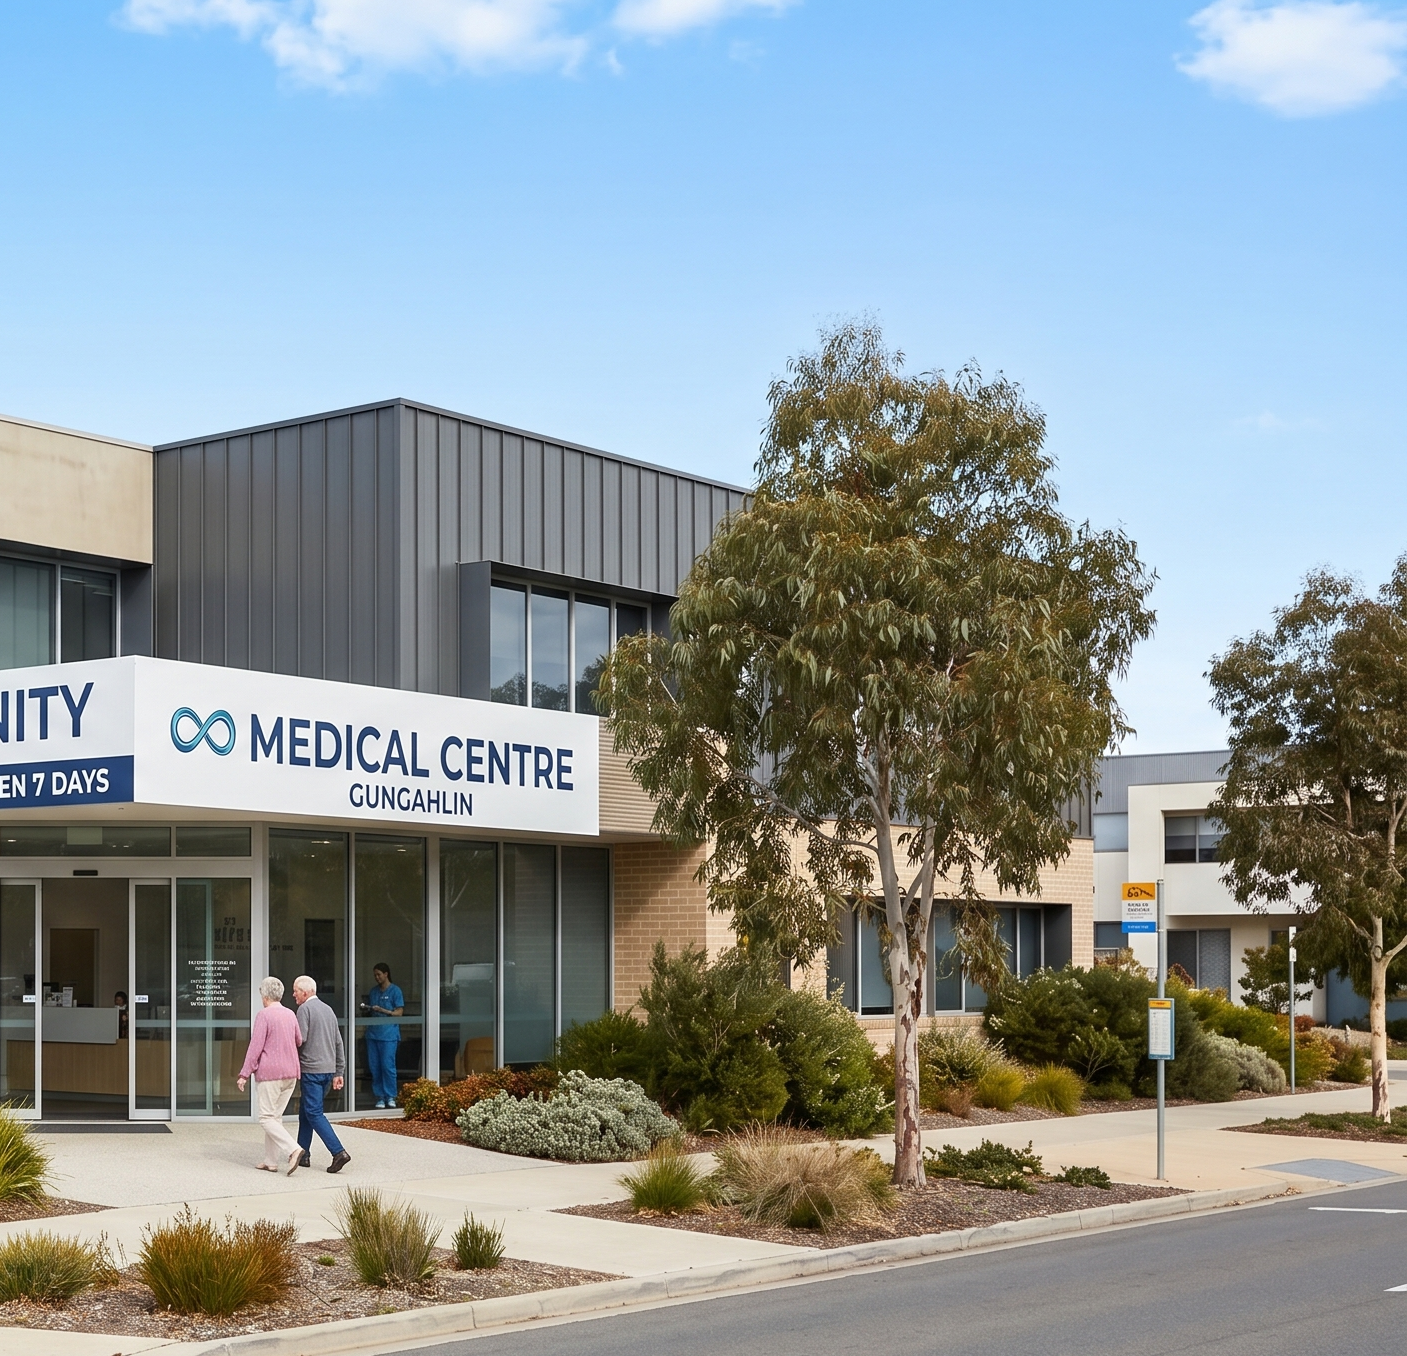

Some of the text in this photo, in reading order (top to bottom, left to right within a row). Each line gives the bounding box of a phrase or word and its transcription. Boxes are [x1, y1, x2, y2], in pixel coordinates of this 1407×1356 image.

[250, 713, 574, 791] MEDICAL CENTRE
[32, 773, 45, 797] 7
[52, 768, 109, 795] DAYS
[349, 783, 473, 816] GUNGAHLIN
